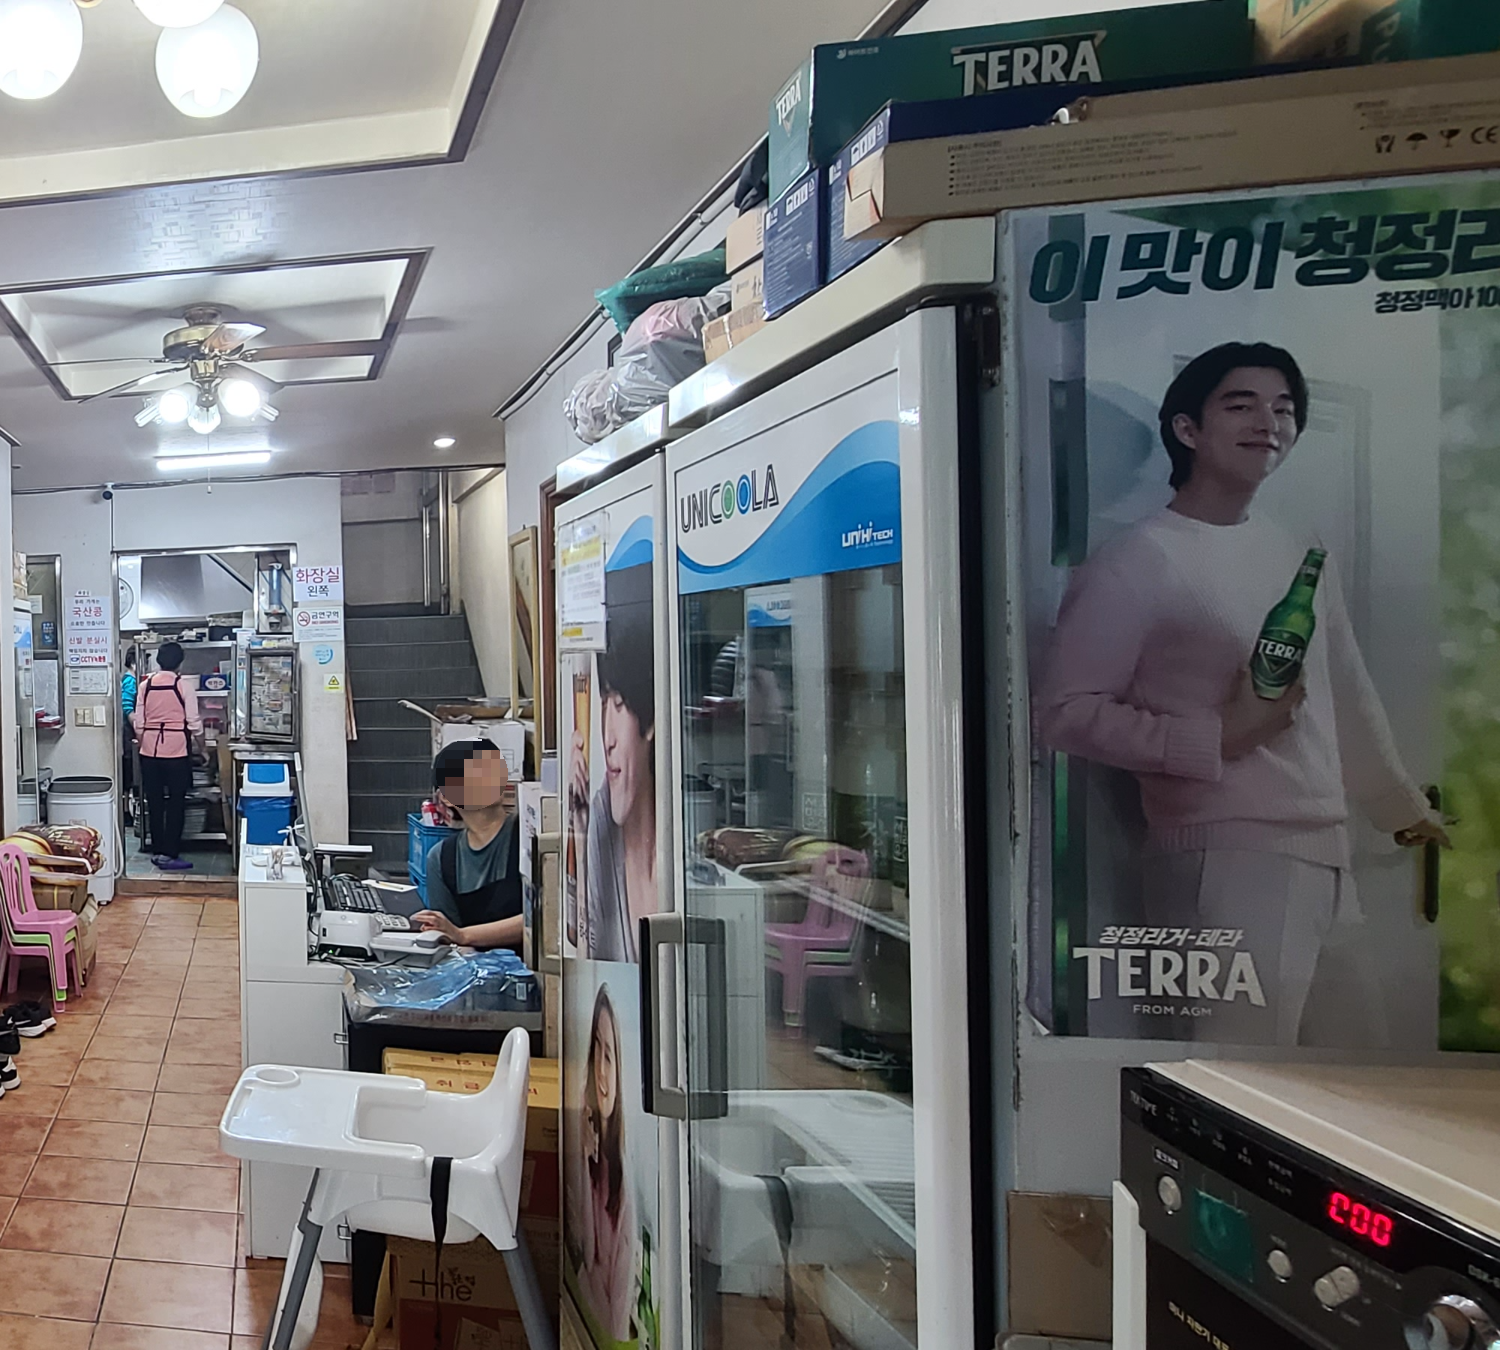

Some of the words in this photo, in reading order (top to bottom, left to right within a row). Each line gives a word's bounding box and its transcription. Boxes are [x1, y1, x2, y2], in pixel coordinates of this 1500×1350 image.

[953, 40, 1102, 97] TERRA
[776, 78, 801, 127] TERRA
[1028, 235, 1110, 306] 이
[1116, 221, 1285, 300] 맛이
[1375, 288, 1474, 314] 청정맥아
[1477, 285, 1500, 308] 10
[680, 463, 780, 534] UNICOOLA
[295, 566, 340, 584] 화장실
[307, 585, 329, 598] 왼쪽
[72, 606, 103, 618] 국산콩
[311, 610, 339, 620] 금연구역
[69, 636, 83, 645] 신발
[86, 636, 107, 645] 분실시
[1258, 638, 1302, 661] TERRA
[1099, 926, 1245, 948] 청정라거-테라
[1073, 947, 1267, 1007] TERRA
[1133, 1004, 1174, 1016] FROM
[1180, 1006, 1213, 1017] AGM
